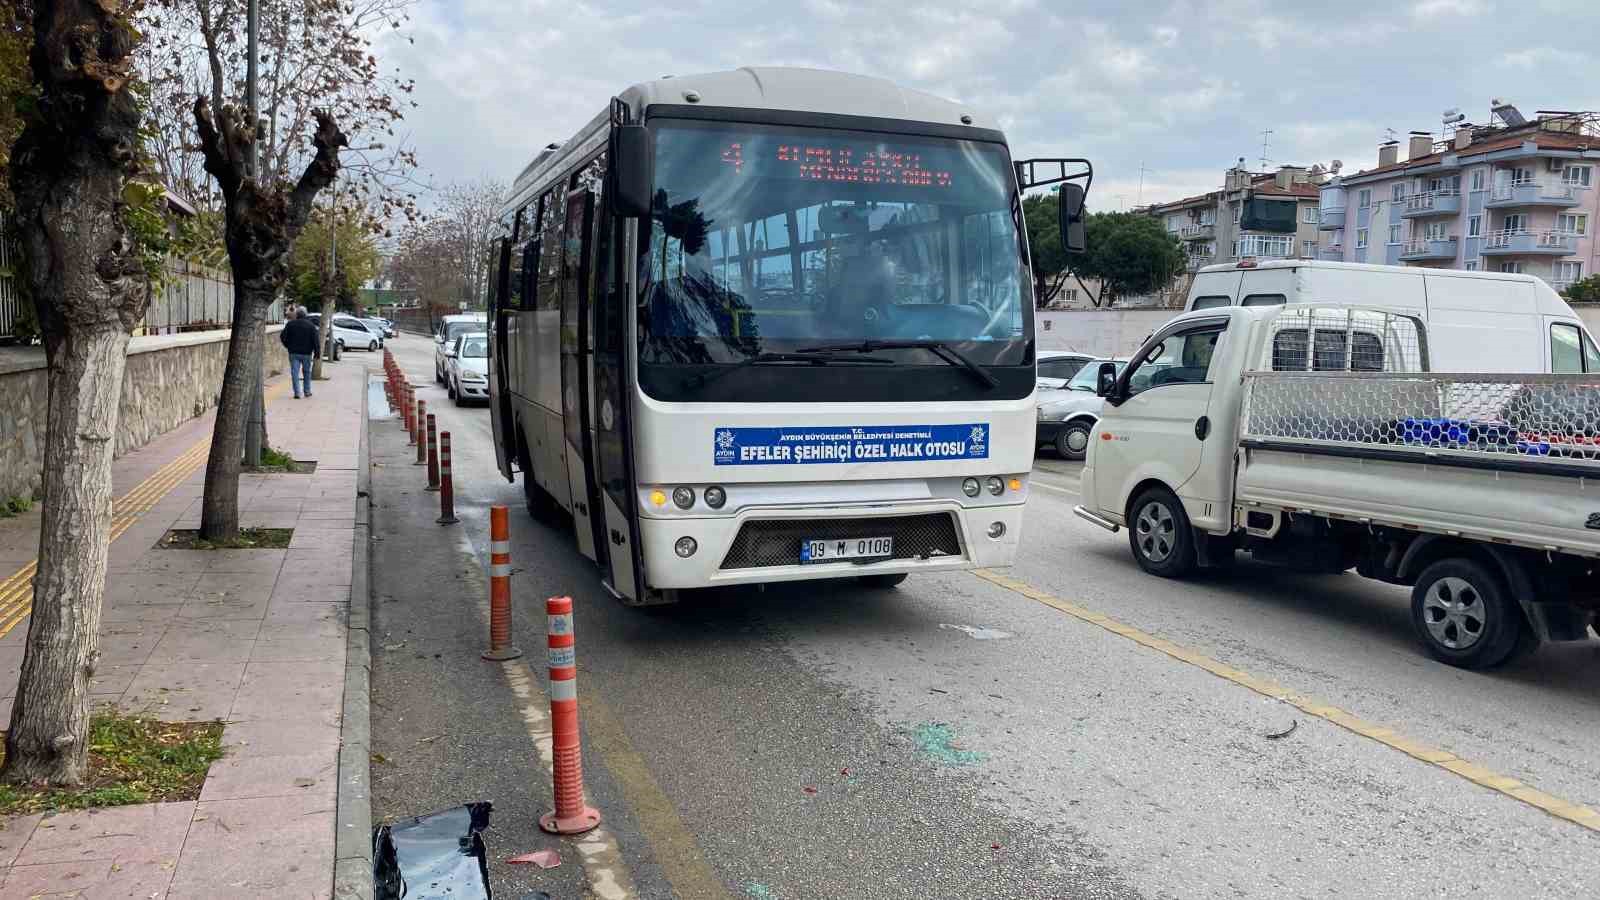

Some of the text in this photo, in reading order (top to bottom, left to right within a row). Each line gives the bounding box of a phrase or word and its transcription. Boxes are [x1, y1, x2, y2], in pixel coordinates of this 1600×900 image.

[721, 143, 743, 174] 4
[805, 432, 851, 441] BÜYÜKŞEHİR
[853, 431, 893, 440] BELEDİYESİ
[895, 430, 931, 439] DENETİMLİ
[715, 449, 735, 457] AYDIN
[740, 440, 966, 463] EFELER ŞEHİRİÇİ ÖZEL HALK OTOSU
[810, 542, 824, 558] 09
[837, 541, 847, 555] M
[858, 539, 891, 554] 0108
